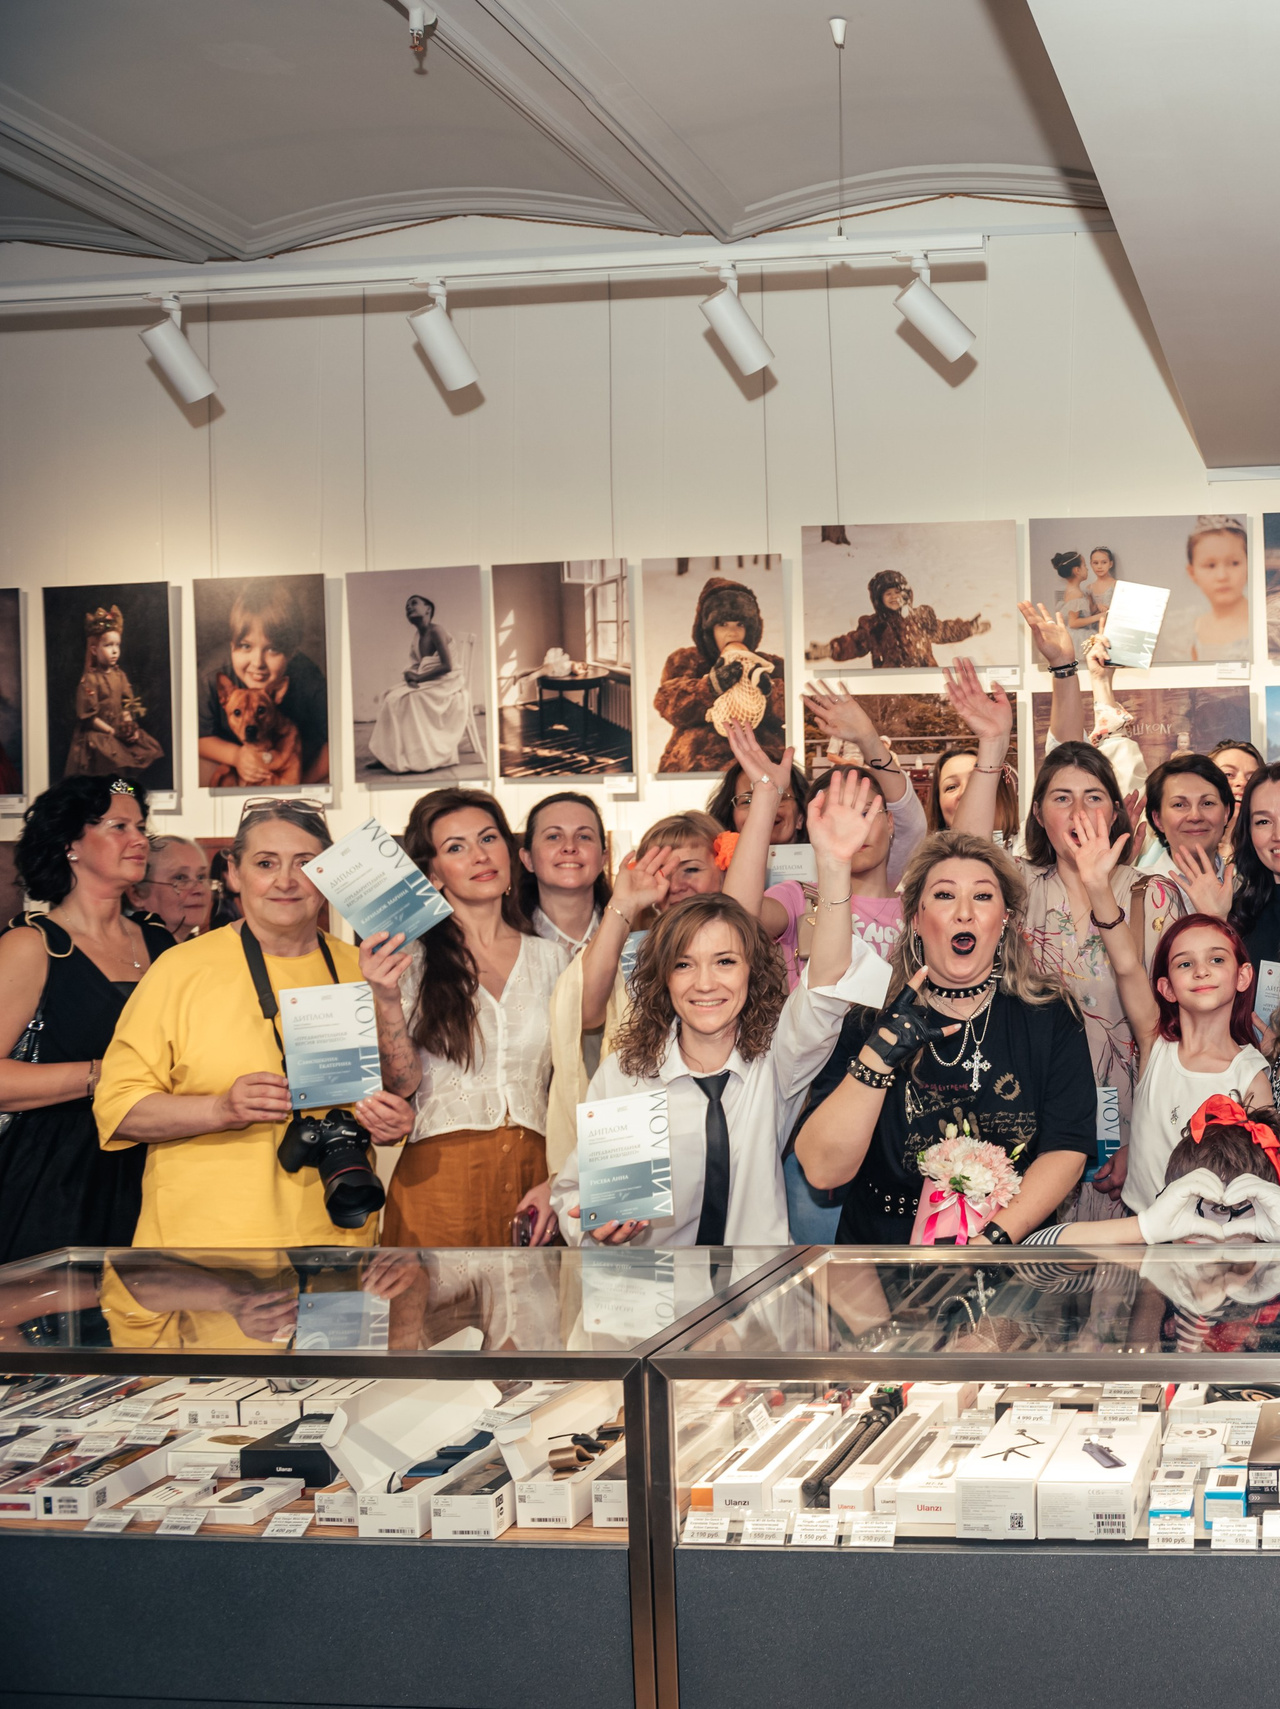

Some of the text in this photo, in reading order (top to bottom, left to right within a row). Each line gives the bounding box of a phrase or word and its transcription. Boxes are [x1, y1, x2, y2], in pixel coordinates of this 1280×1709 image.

[329, 861, 364, 889] ДИПЛОМ
[293, 1012, 333, 1023] ДИПЛОМ
[588, 1124, 628, 1137] ДИПЛОМ
[649, 1089, 674, 1216] ДИПЛОМ
[70, 1463, 121, 1486] Slim
[724, 1499, 749, 1507] Ulanzi
[917, 1504, 942, 1512] Ulanzi
